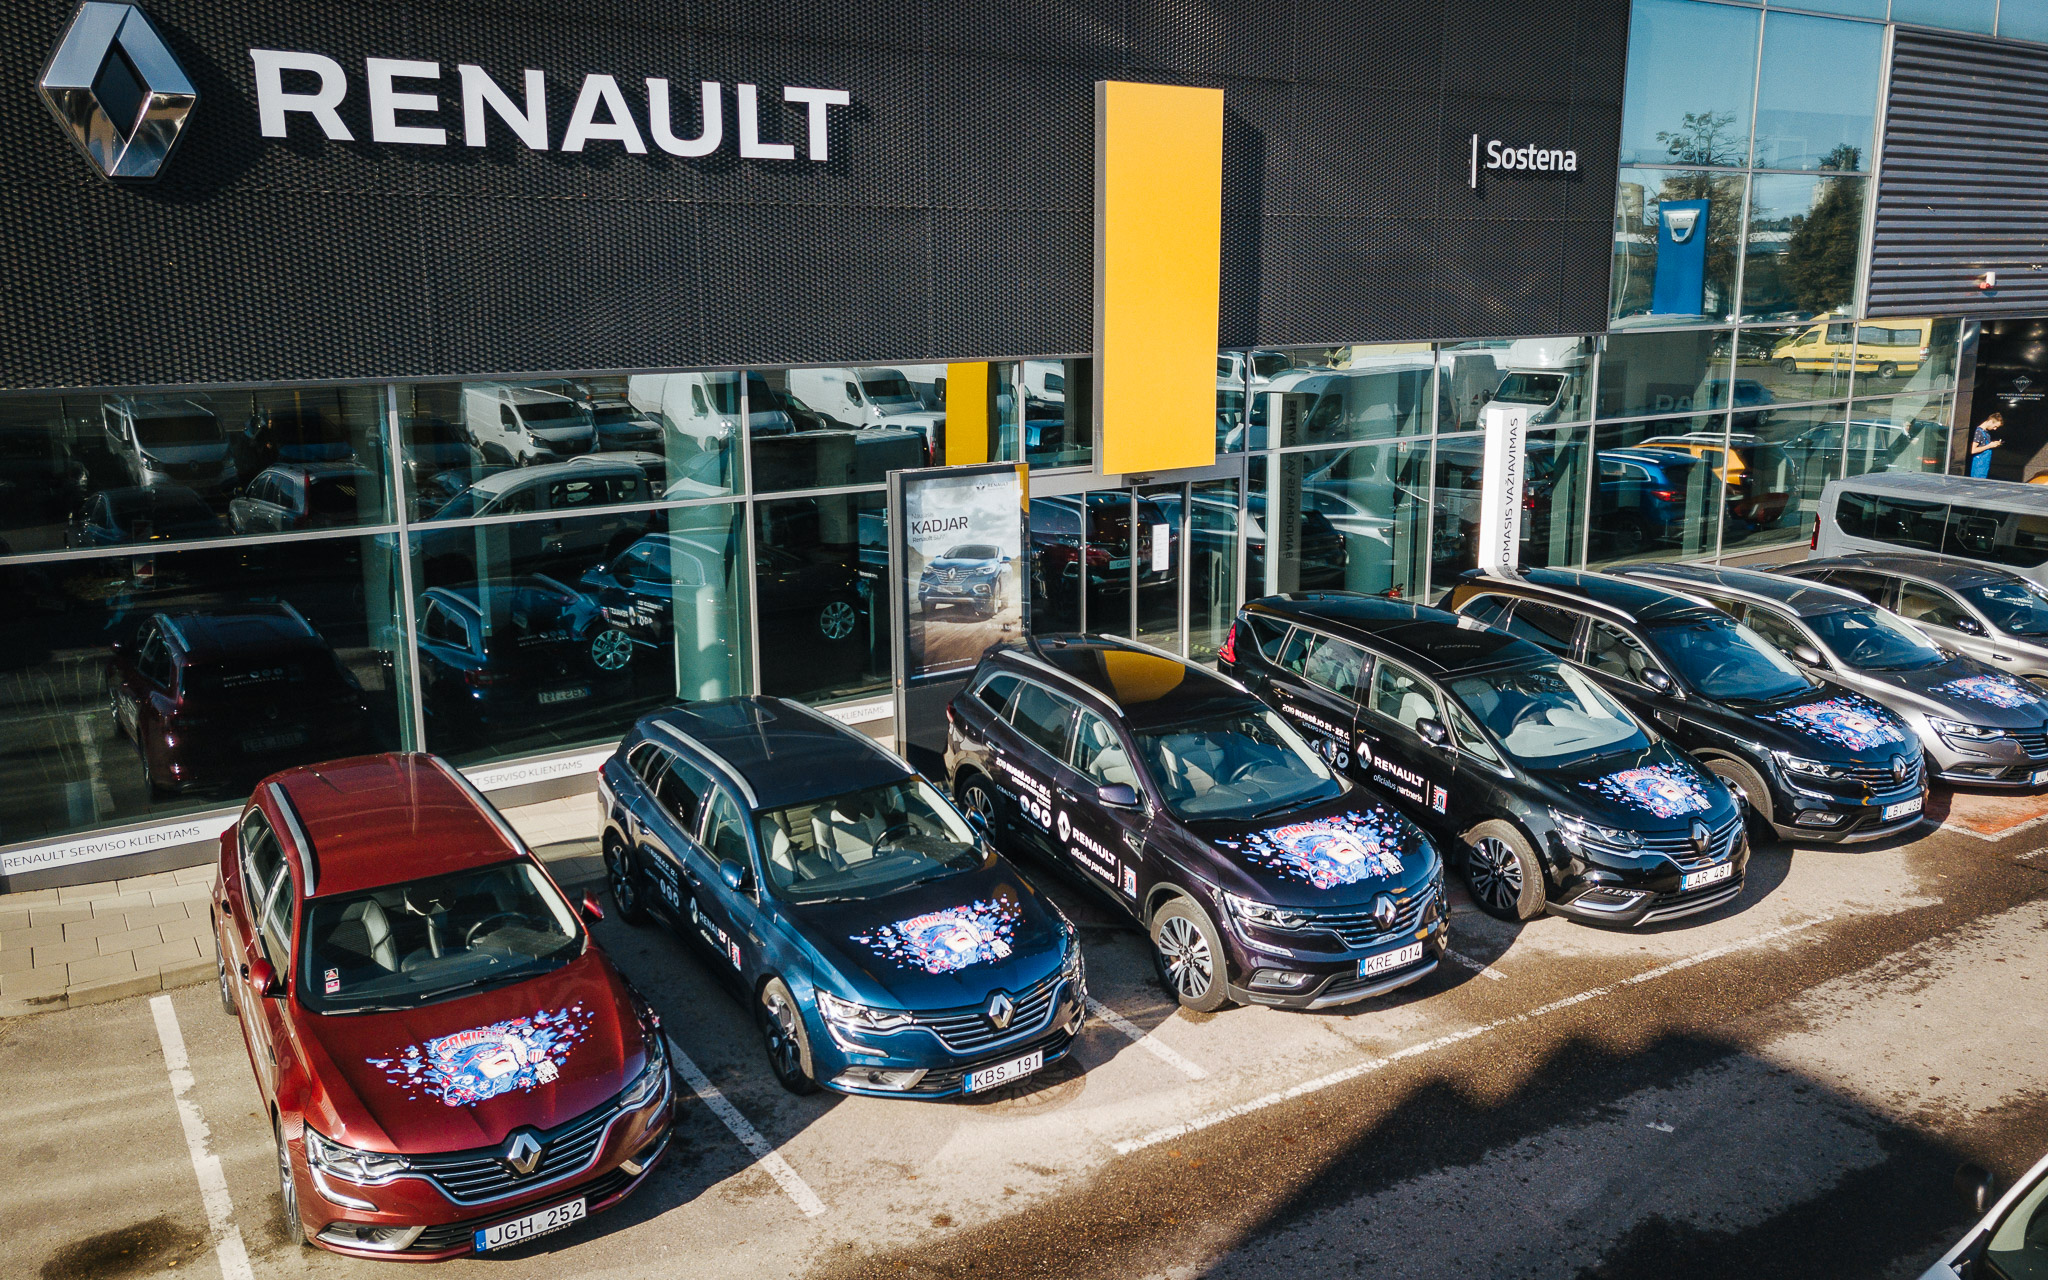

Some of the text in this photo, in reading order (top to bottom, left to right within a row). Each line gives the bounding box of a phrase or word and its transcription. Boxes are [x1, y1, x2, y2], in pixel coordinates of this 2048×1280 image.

[250, 48, 850, 162] RENAULT
[1486, 140, 1577, 171] Sostena
[1504, 417, 1519, 505] VAŽIAVIMAS
[911, 516, 968, 535] KADJAR
[483, 770, 526, 785] SERVISO
[528, 760, 583, 776] KLIENTAMS
[1374, 756, 1424, 788] RENAULT
[1373, 774, 1423, 804] oficialus partneris
[4, 826, 201, 868] RENAULT SERVISO KLIENTAMS
[1072, 826, 1117, 866] RENAULT
[1091, 861, 1116, 884] partneris
[1687, 871, 1708, 887] LAR
[699, 911, 727, 943] RENAULT
[1367, 953, 1393, 972] KRE
[1400, 945, 1420, 962] 014
[974, 1054, 1039, 1088] KBS 191
[489, 1201, 583, 1245] JGH 252
[476, 1241, 486, 1249] LT
